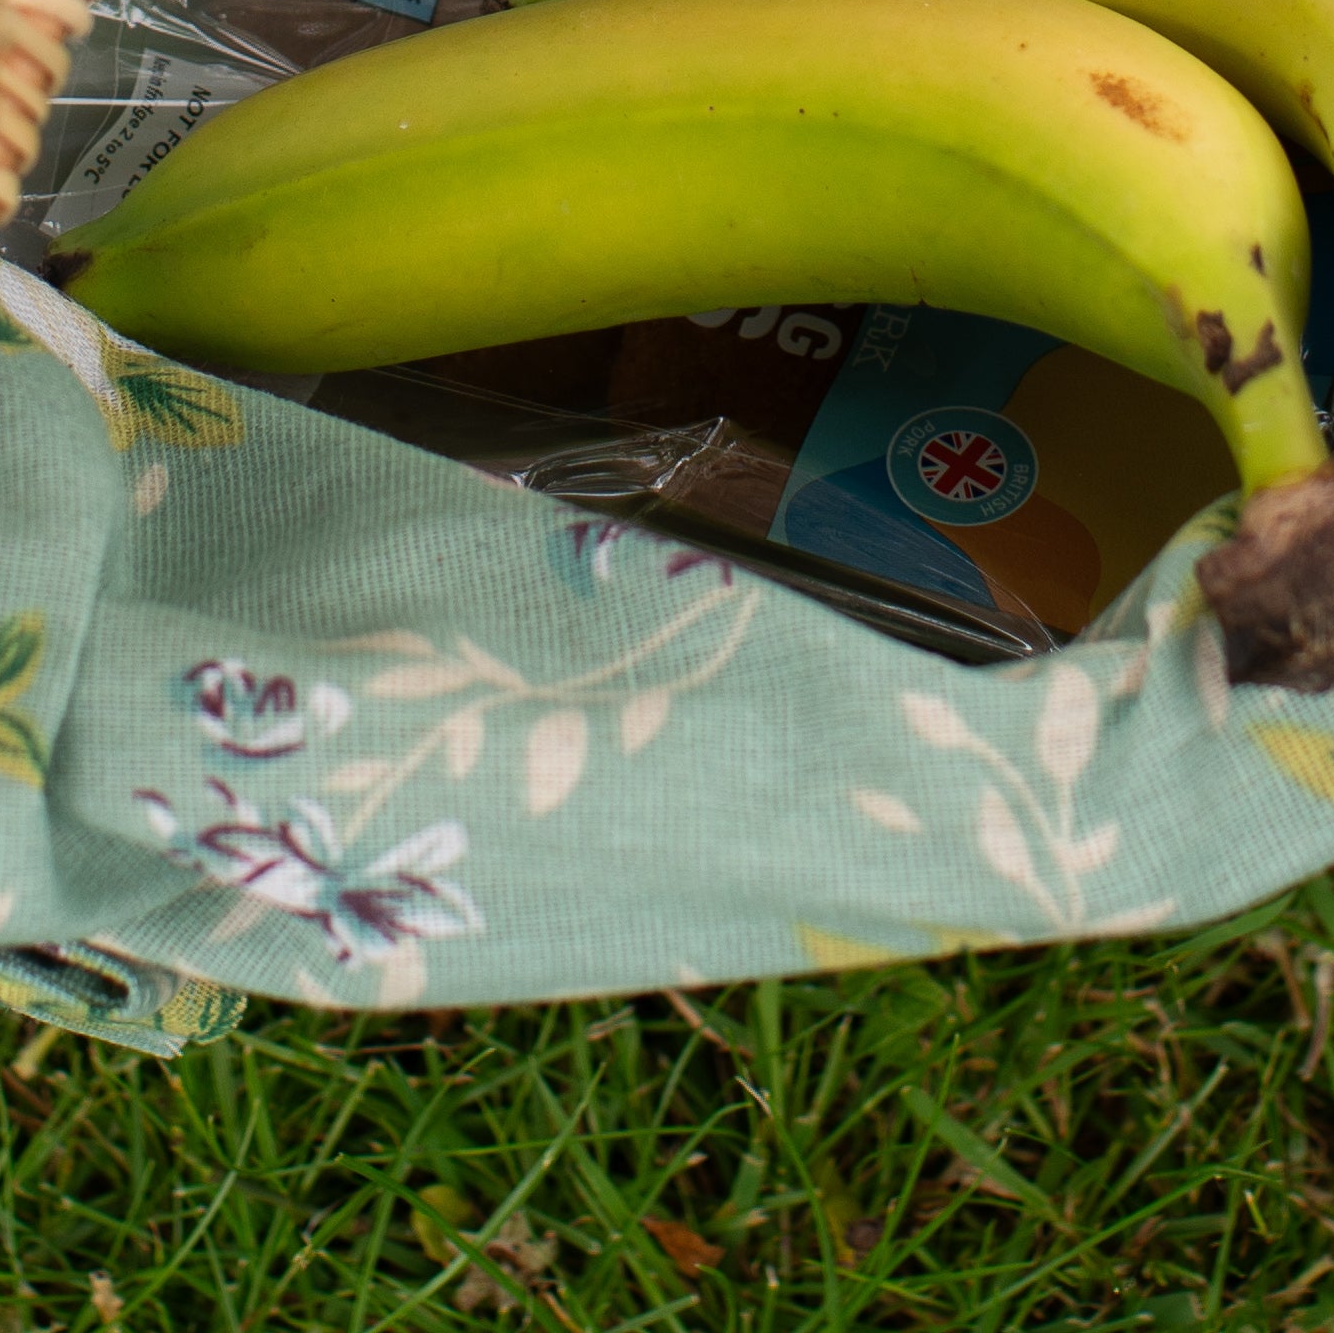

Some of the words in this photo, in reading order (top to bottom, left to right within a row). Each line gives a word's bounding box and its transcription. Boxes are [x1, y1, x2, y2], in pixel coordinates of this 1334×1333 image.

[179, 86, 213, 131] NOT
[105, 138, 124, 156] to
[121, 128, 134, 142] 2
[856, 303, 912, 372] RK
[896, 419, 935, 457] PORK
[979, 462, 1029, 517] BRITISH
